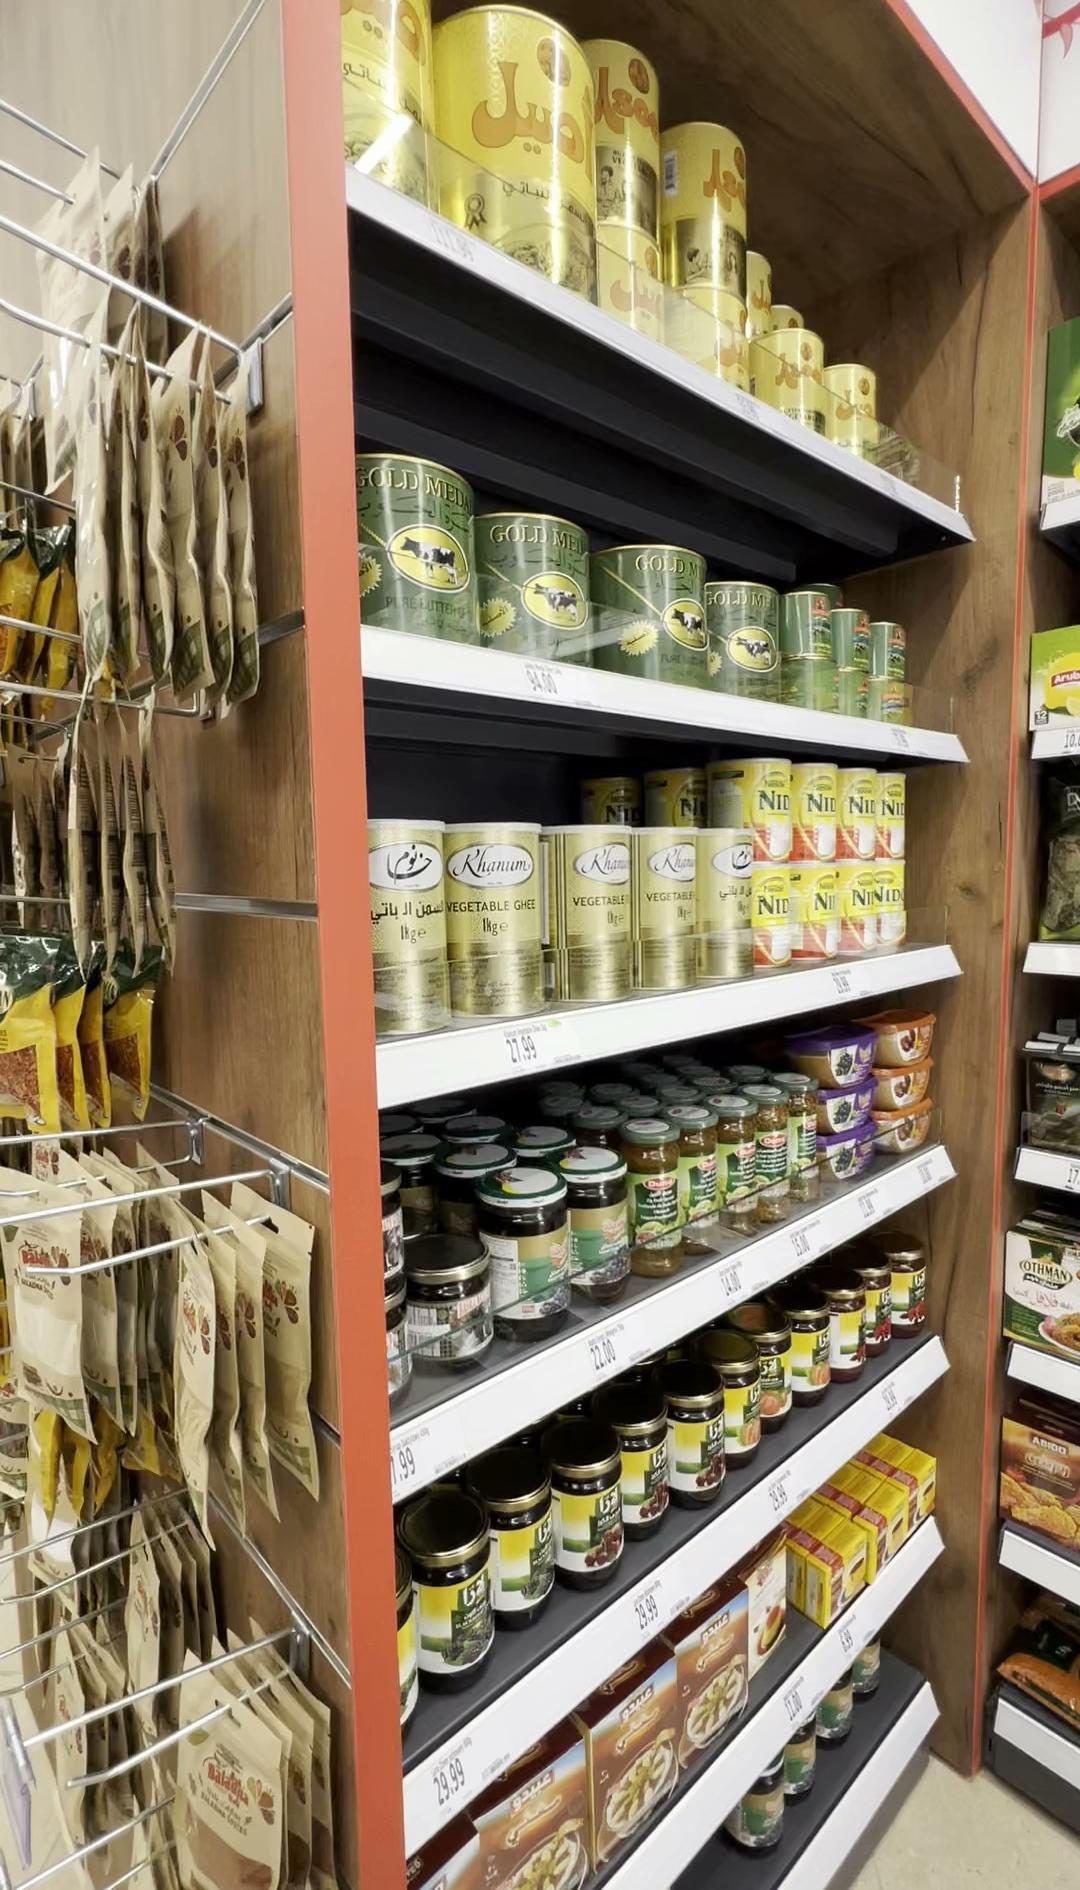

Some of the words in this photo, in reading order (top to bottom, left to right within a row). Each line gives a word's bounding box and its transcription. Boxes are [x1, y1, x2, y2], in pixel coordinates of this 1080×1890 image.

[489, 524, 548, 544] GOLD
[635, 553, 686, 575] GOLD
[705, 590, 749, 606] GOLD
[451, 844, 531, 879] Khanum
[446, 901, 511, 913] VEGETABLE
[513, 899, 537, 911] GHEE
[572, 894, 626, 907] VEGETABLE
[505, 1035, 537, 1064] 27.99
[1023, 1261, 1068, 1281] OTHMAN
[589, 1339, 616, 1371] 22.00
[634, 1594, 659, 1631] 29.99
[433, 1757, 466, 1807] 29.99
